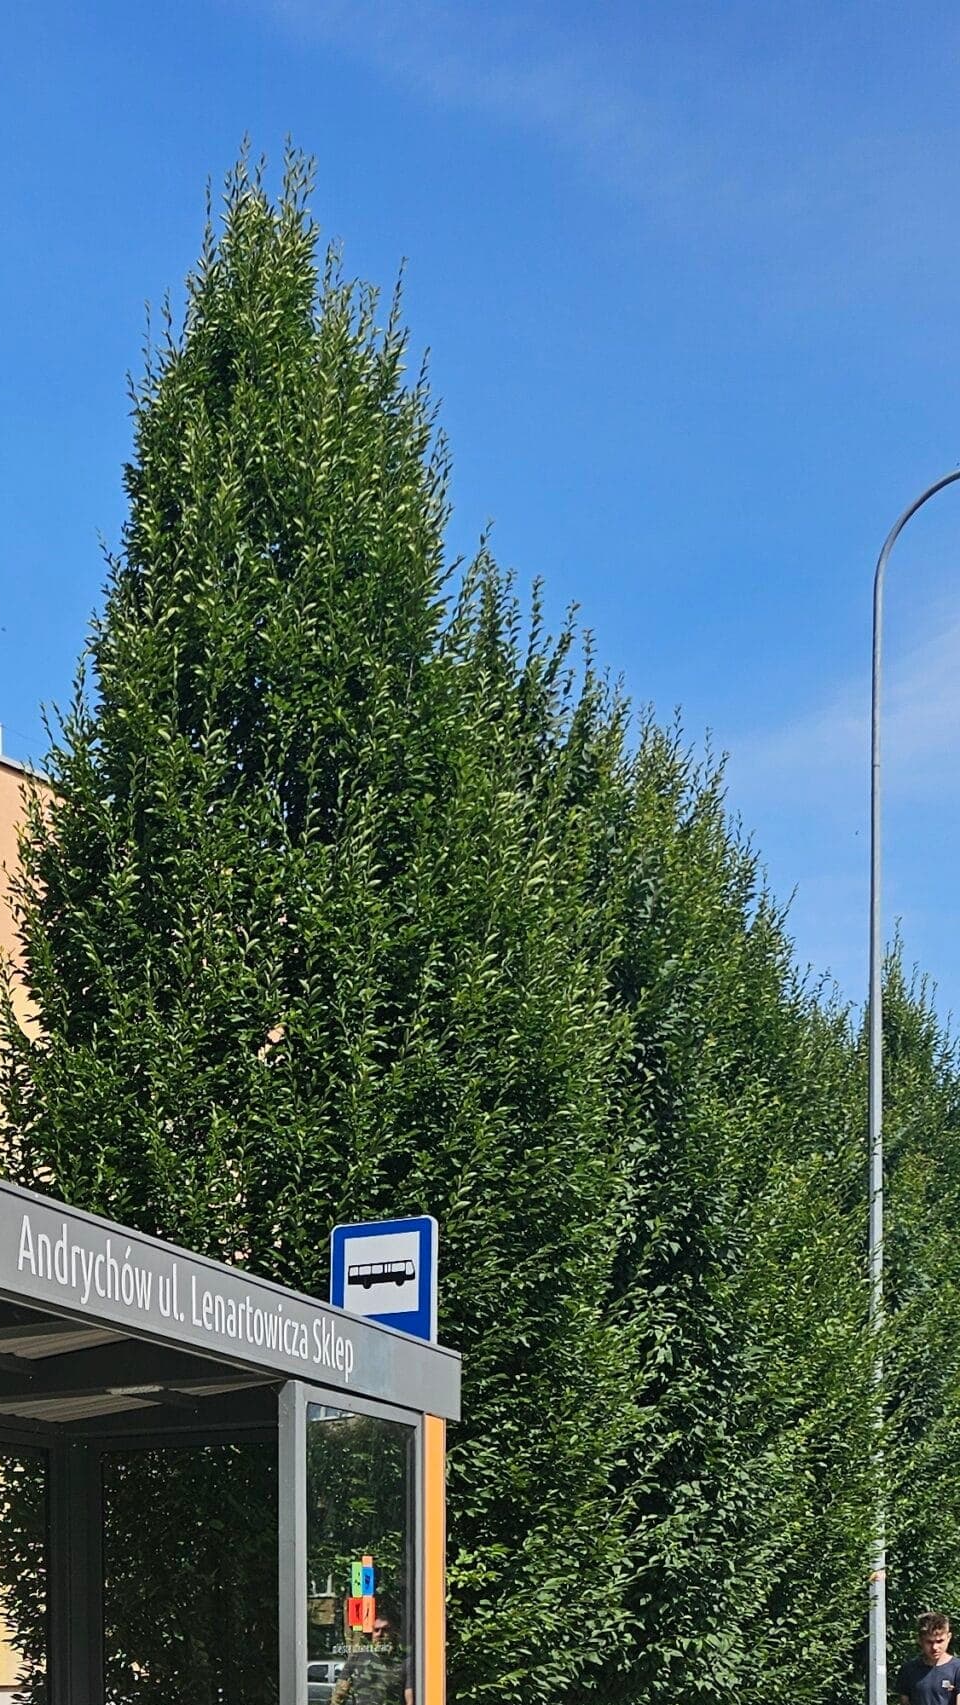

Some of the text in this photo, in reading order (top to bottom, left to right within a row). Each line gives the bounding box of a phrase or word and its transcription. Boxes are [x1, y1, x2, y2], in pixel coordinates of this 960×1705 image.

[17, 1214, 355, 1383] Andrychów ul. Lenartowicza Sklep
